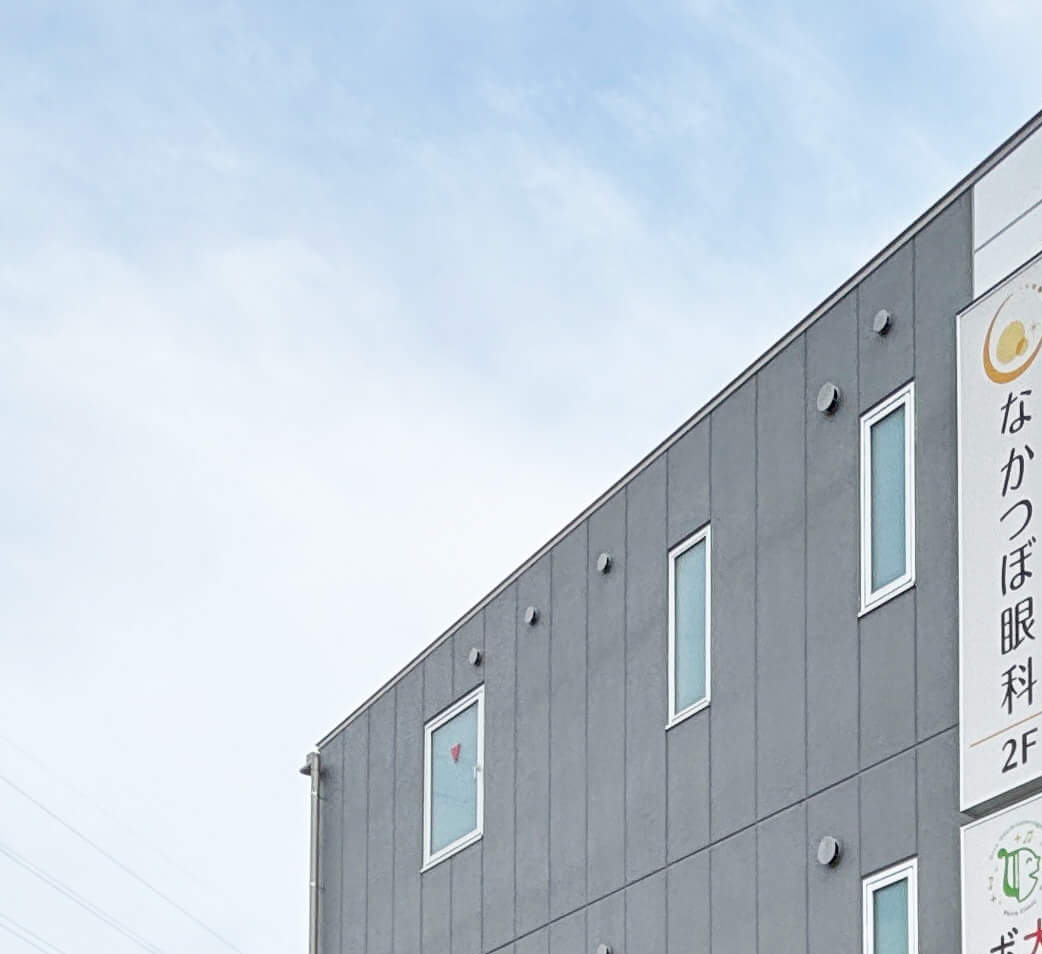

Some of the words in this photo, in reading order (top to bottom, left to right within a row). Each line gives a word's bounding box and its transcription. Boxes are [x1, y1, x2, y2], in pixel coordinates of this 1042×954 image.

[1000, 389, 1037, 715] なかつぼ眼科
[1001, 728, 1038, 773] 2F
